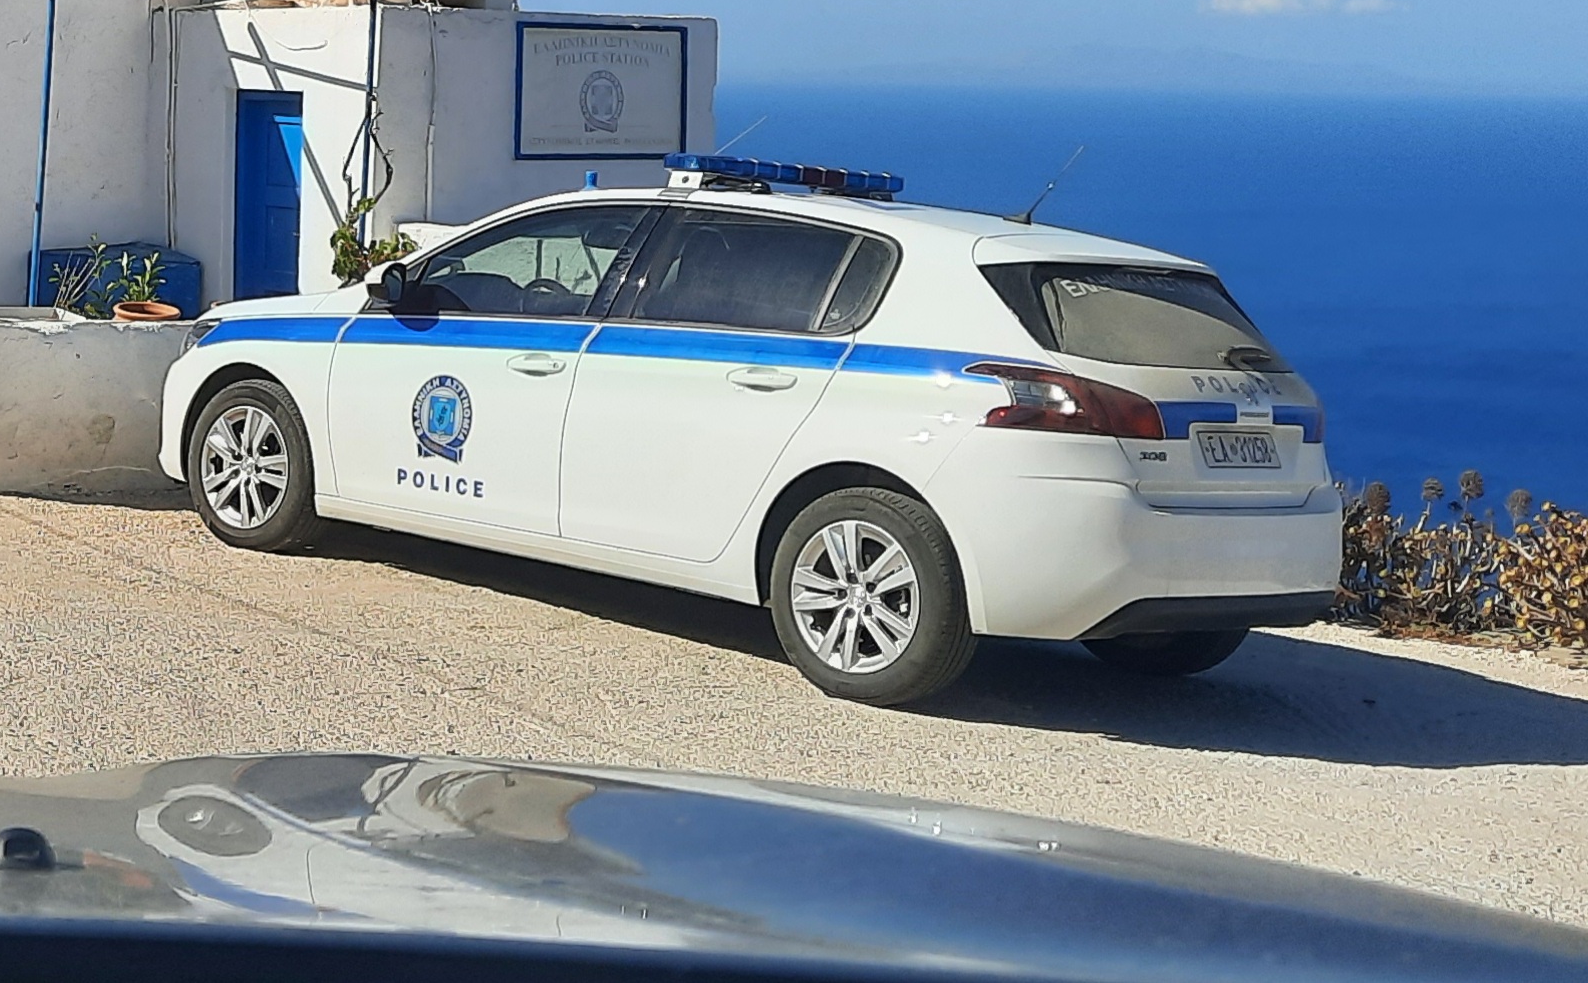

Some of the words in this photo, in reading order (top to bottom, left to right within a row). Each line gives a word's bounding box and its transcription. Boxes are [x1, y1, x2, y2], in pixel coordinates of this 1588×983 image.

[555, 51, 597, 66] POLICE
[601, 51, 650, 68] STATION
[397, 468, 484, 498] POLICE
